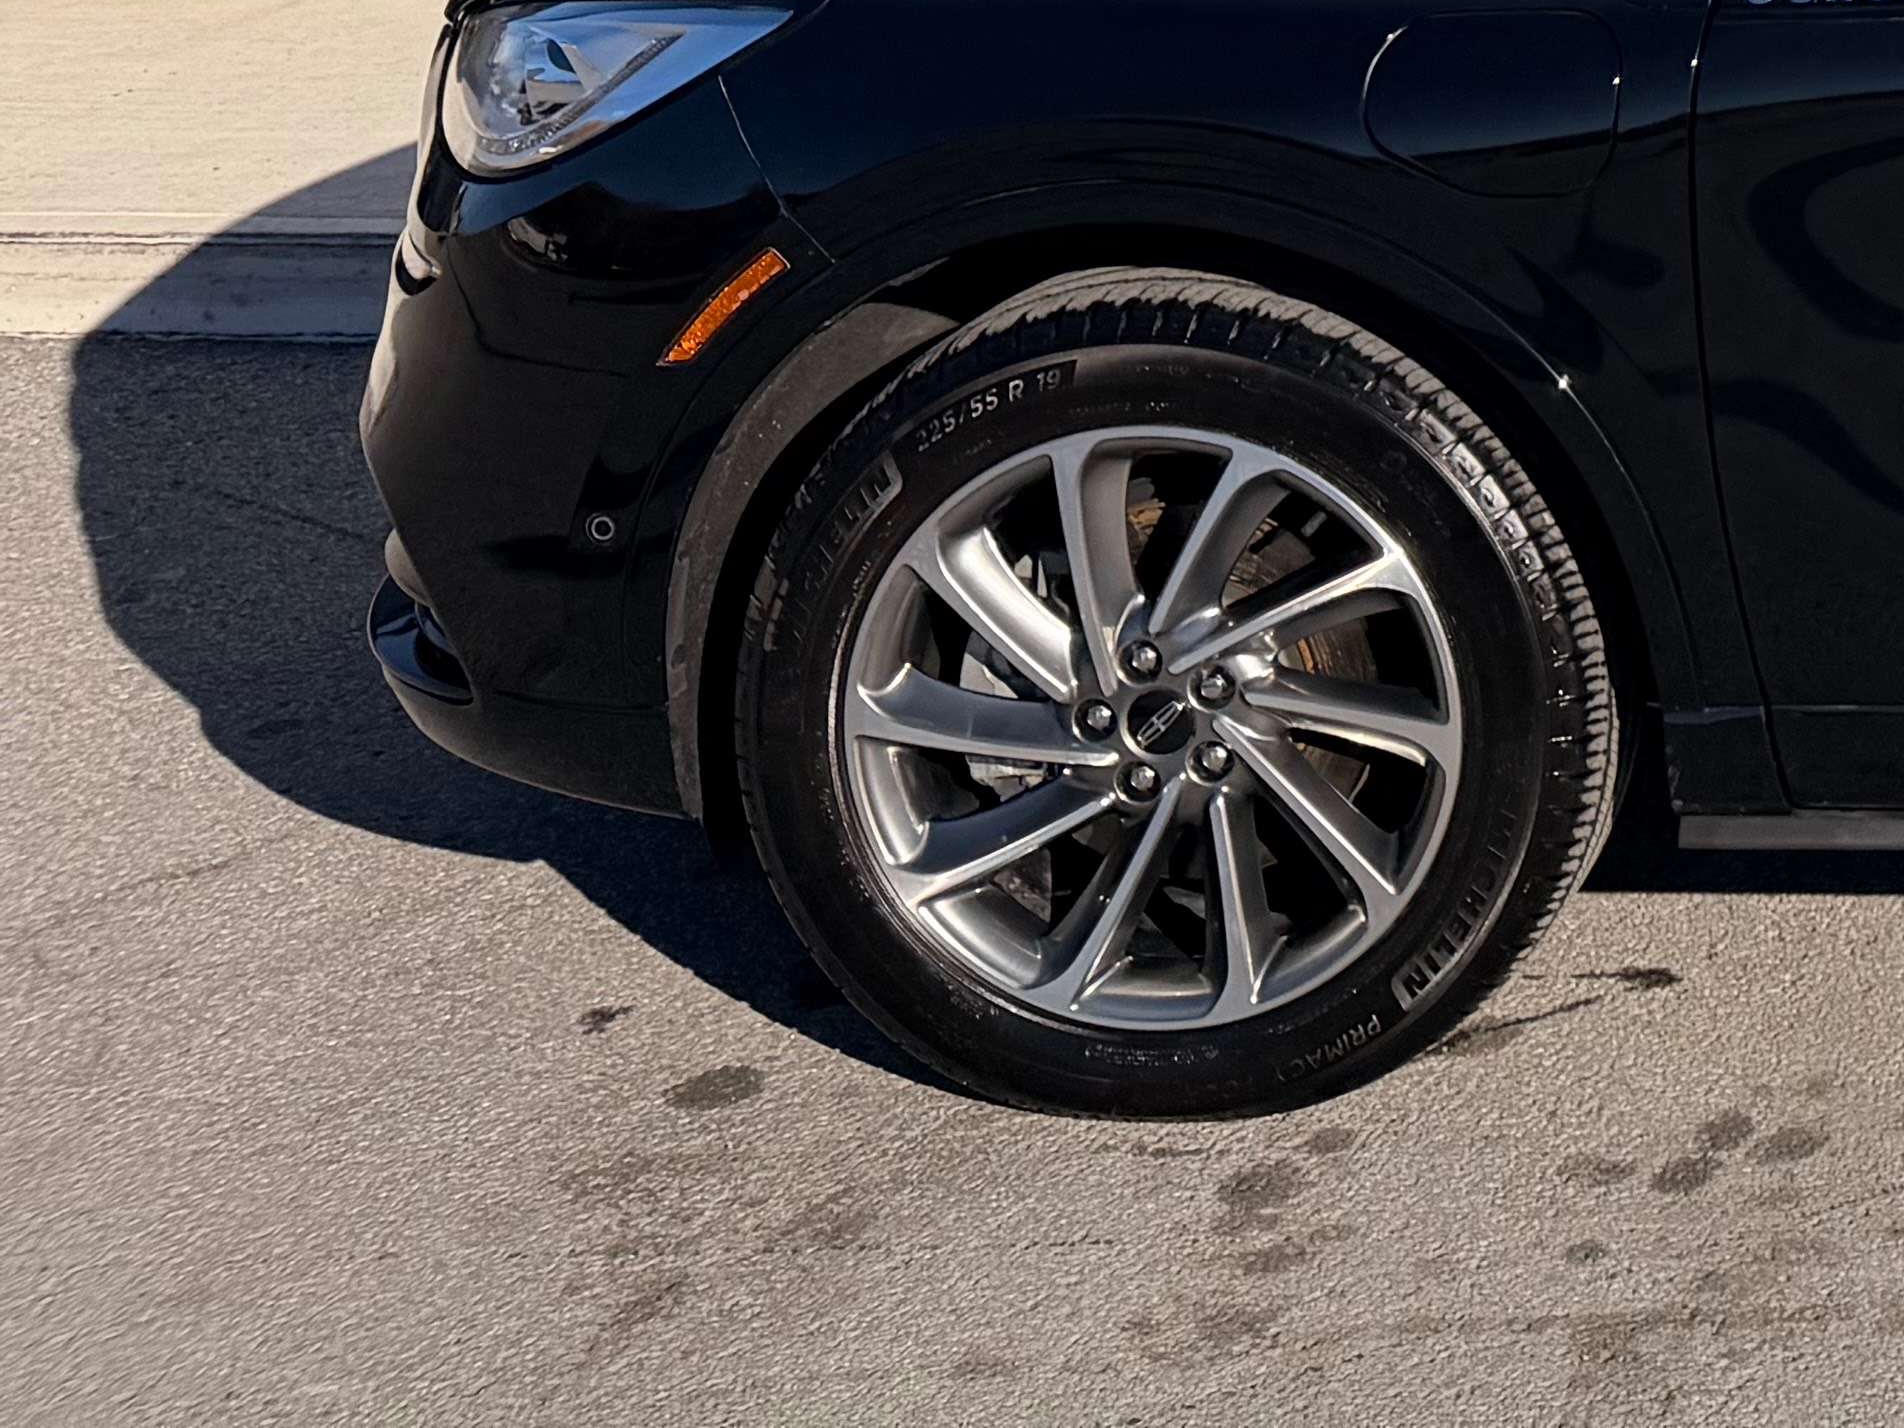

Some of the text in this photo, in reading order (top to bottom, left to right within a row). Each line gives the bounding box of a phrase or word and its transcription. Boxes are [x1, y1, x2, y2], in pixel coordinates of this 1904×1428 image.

[914, 367, 1062, 453] 225/55 R 19
